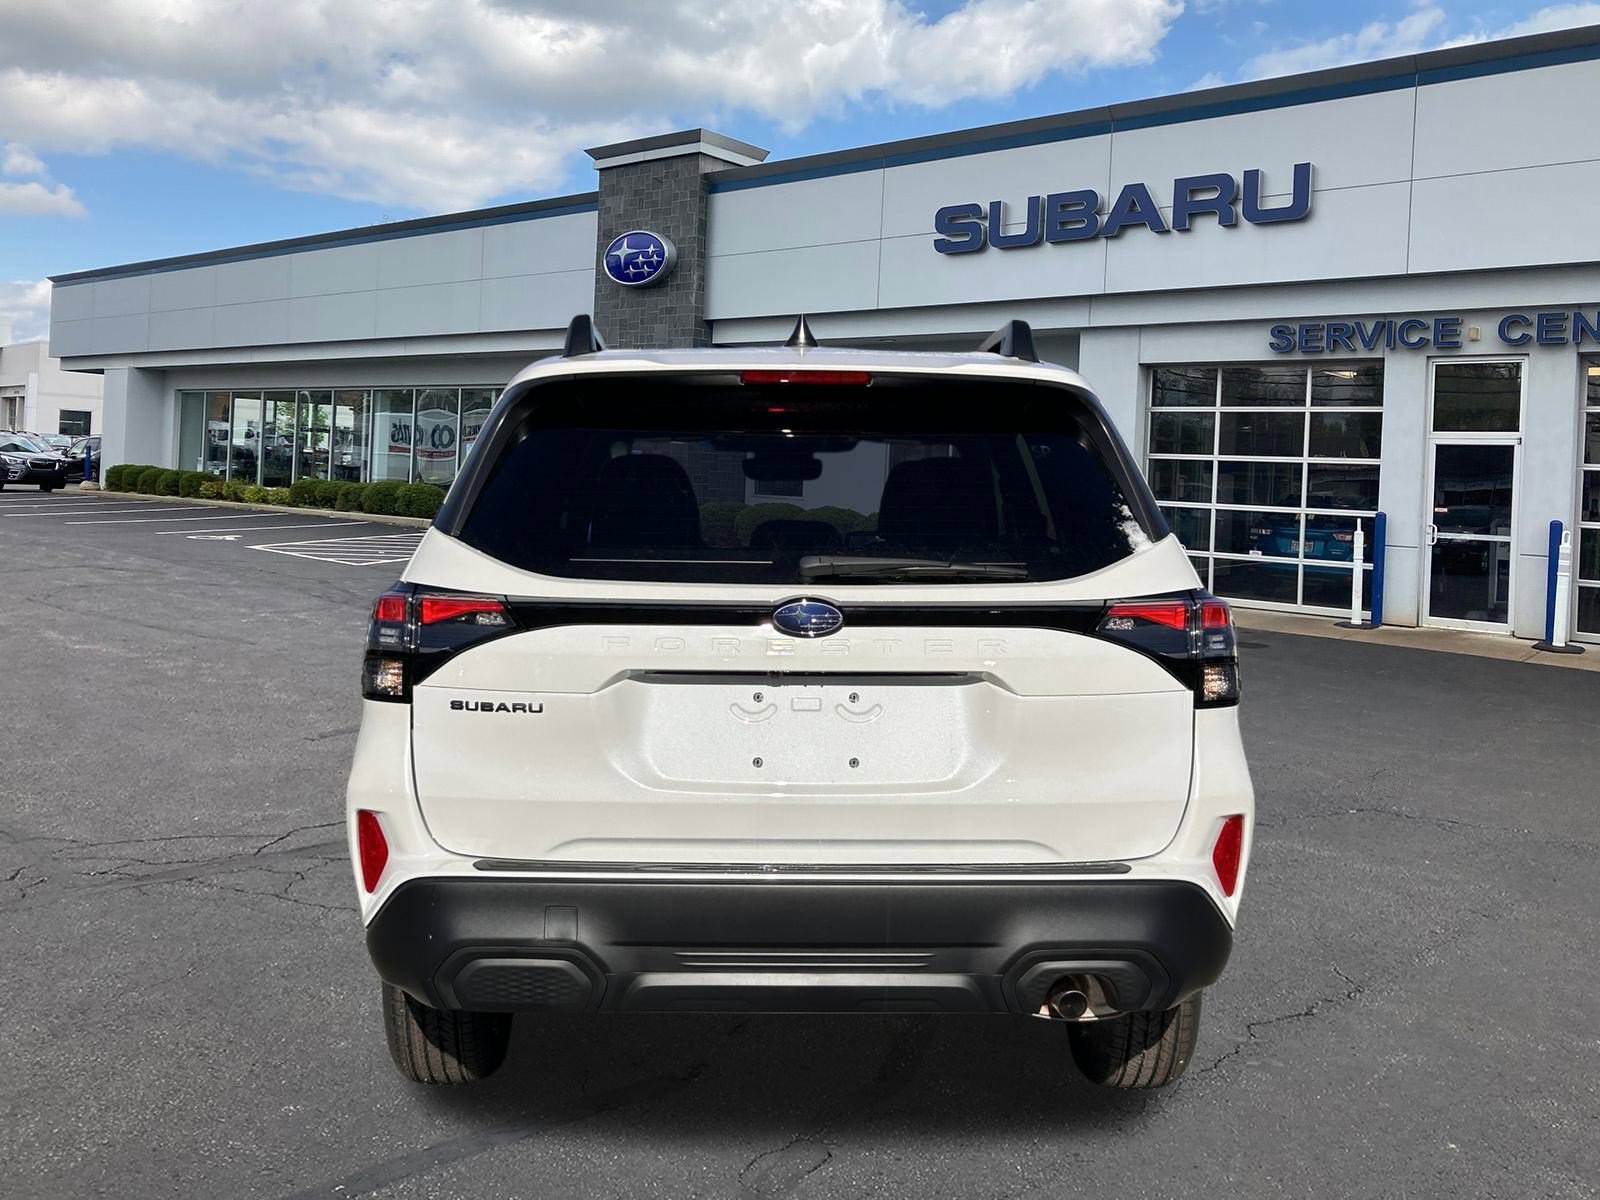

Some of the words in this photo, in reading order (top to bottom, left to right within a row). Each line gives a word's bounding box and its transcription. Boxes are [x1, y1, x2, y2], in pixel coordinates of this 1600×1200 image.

[934, 162, 1313, 254] SUBARU
[1269, 318, 1463, 353] SERVICE
[601, 636, 1009, 656] FORESTER
[450, 700, 544, 713] SUBARU
